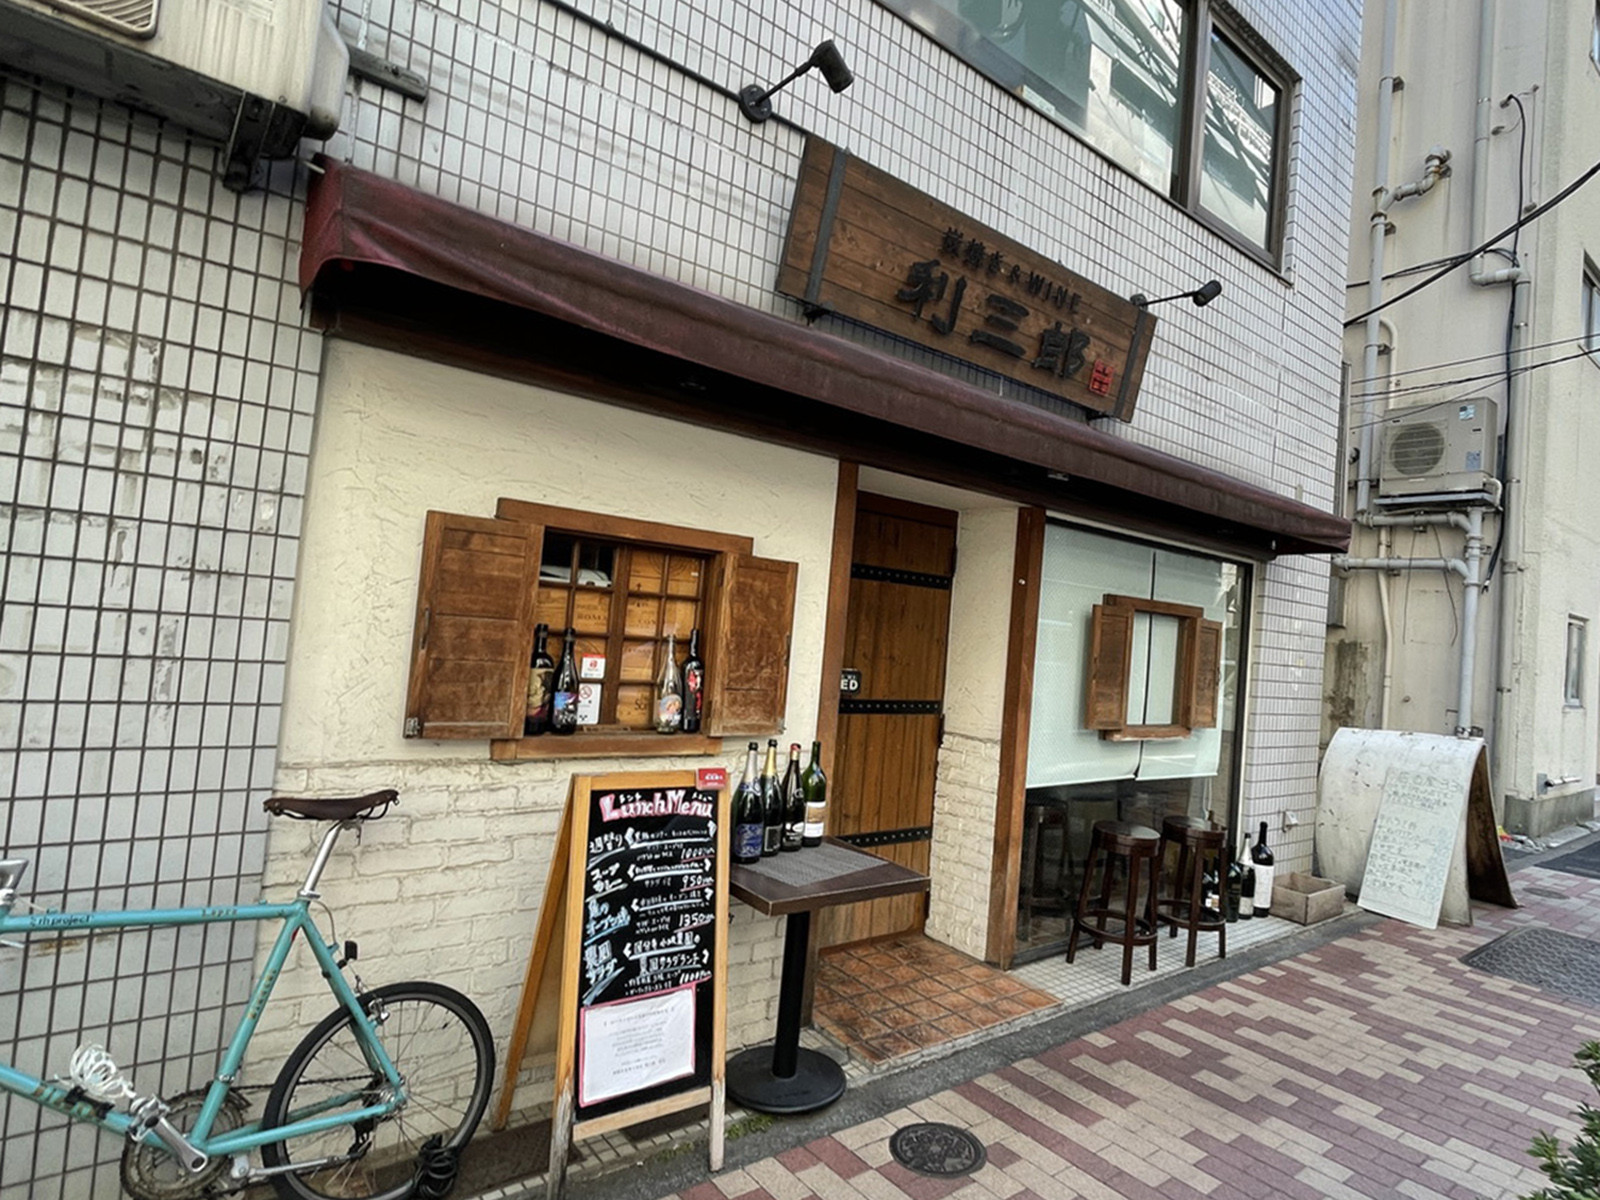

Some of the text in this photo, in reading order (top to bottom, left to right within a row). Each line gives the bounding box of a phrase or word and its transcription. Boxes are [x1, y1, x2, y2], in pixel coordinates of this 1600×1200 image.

[1027, 271, 1082, 315] WINE
[896, 258, 1091, 379] 利三郎
[599, 789, 714, 823] Lunch Menu
